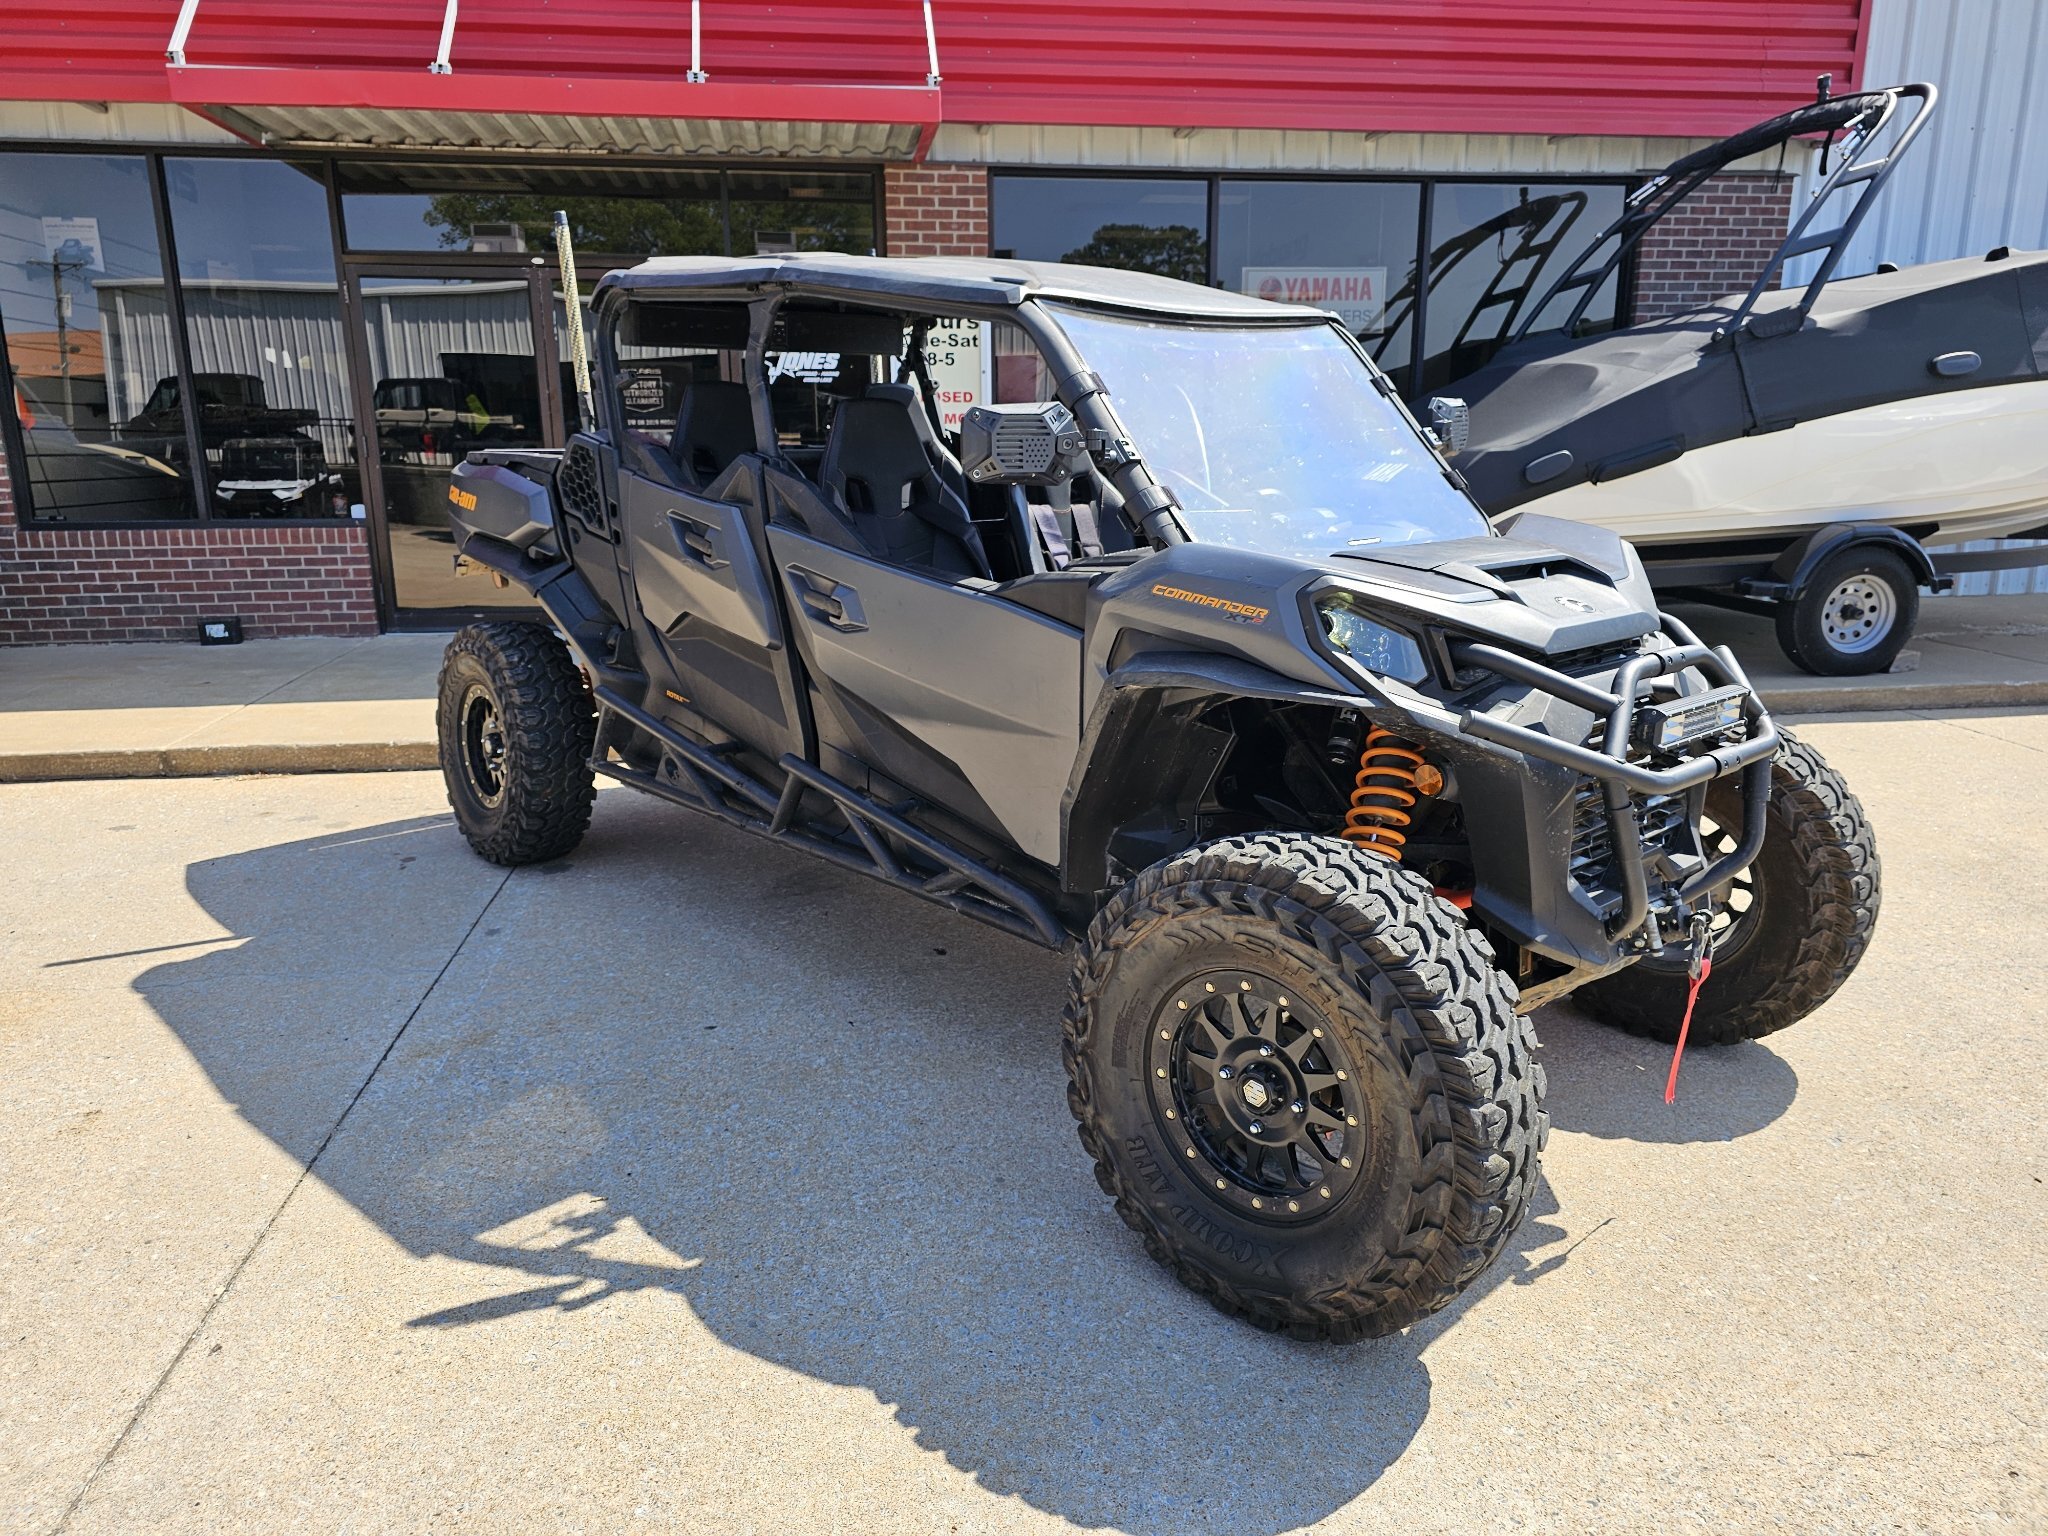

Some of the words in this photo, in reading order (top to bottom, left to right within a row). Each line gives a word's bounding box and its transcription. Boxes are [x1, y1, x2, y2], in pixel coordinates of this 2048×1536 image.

[1285, 277, 1372, 301] YAMAHA
[930, 333, 979, 347] e-Sat
[768, 351, 840, 377] JONES
[927, 352, 955, 366] 8-5
[1152, 584, 1269, 618] COMMANDER
